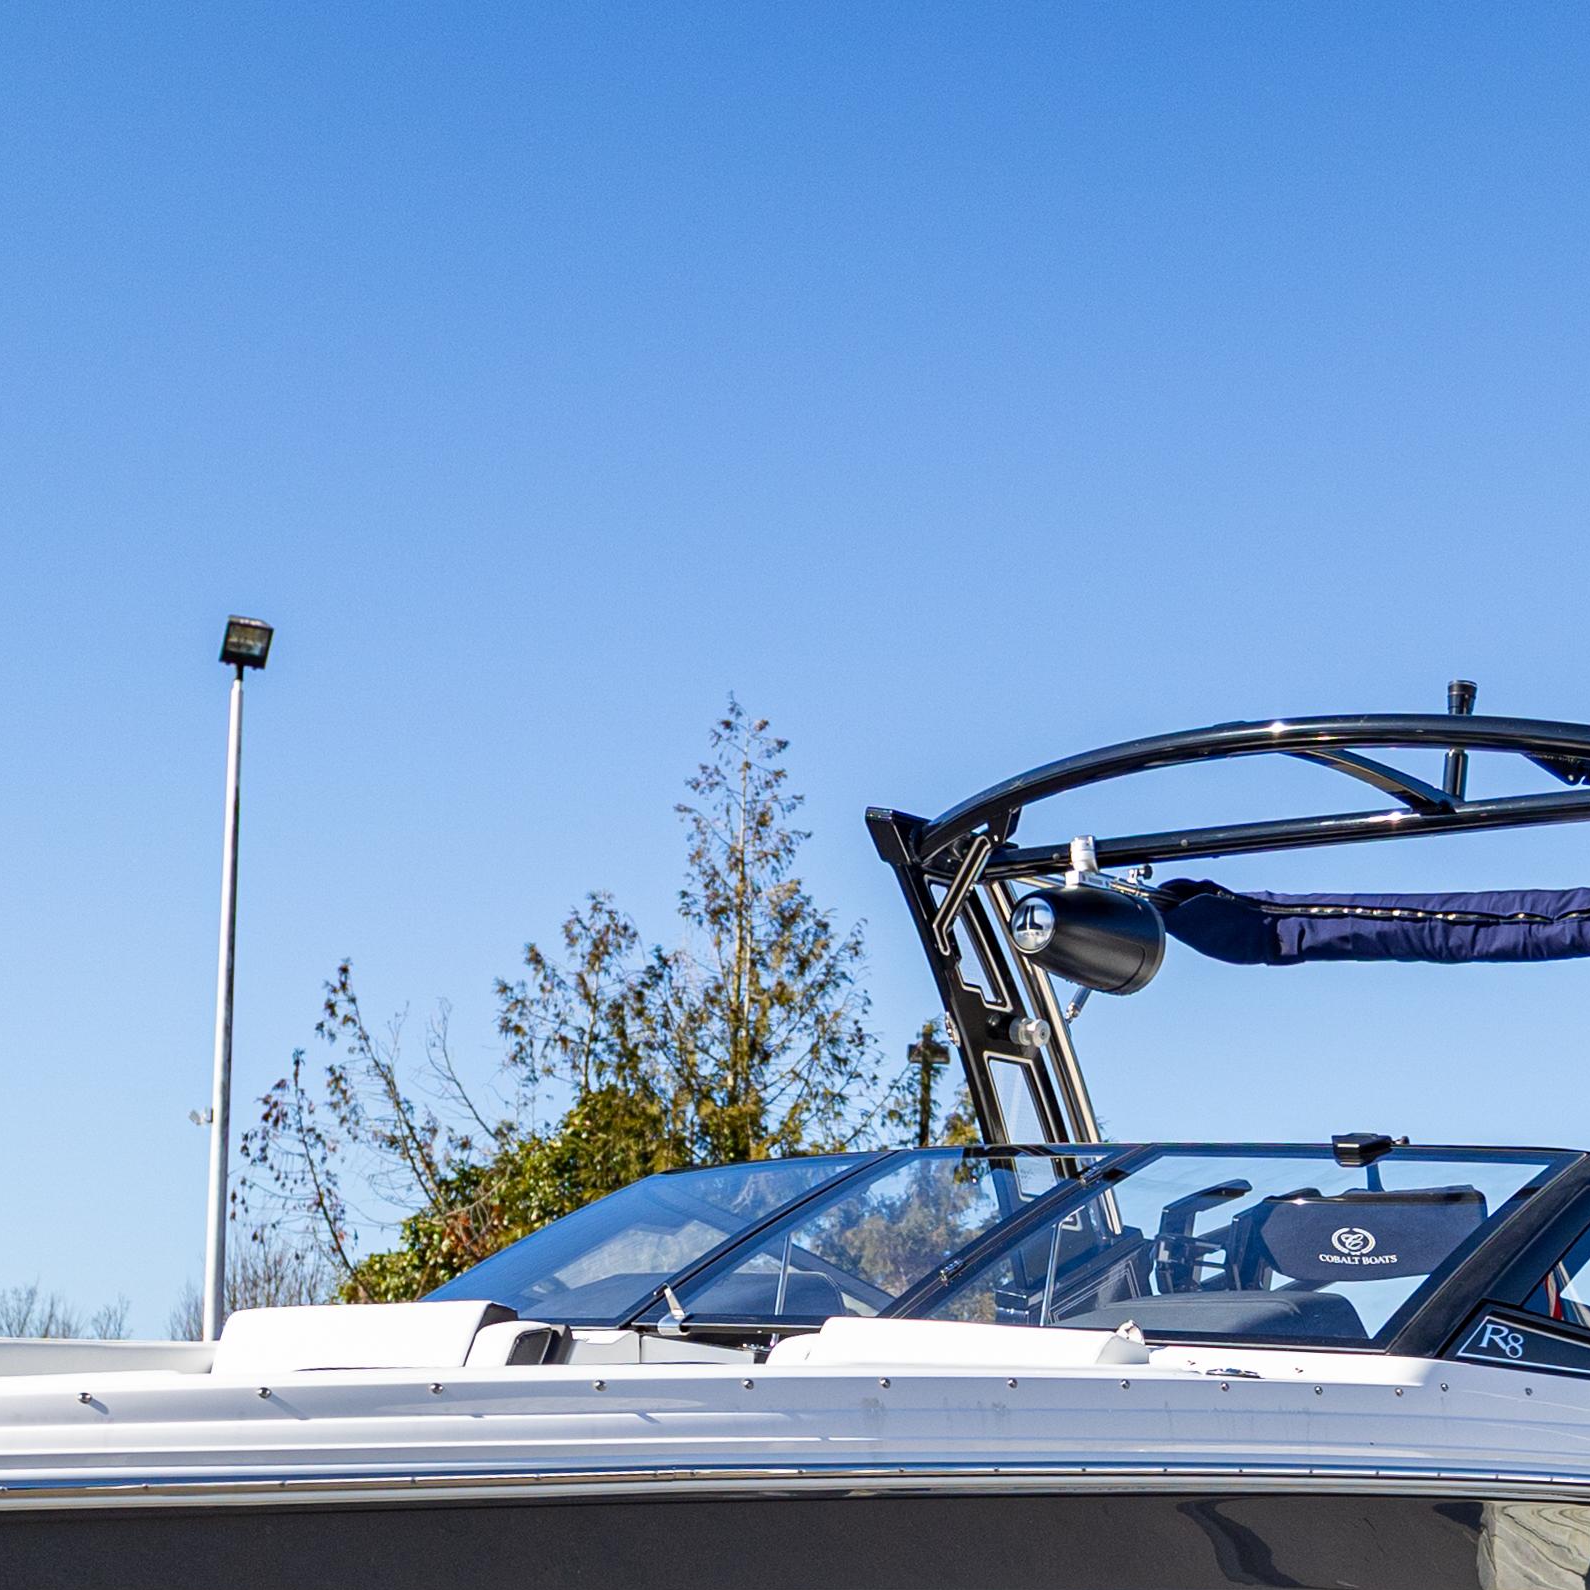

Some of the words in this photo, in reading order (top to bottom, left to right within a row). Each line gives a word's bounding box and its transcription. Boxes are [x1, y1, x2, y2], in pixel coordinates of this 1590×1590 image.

[1318, 1253, 1360, 1265] COBALT
[1362, 1254, 1398, 1265] BOATS
[1478, 1323, 1525, 1358] R8
